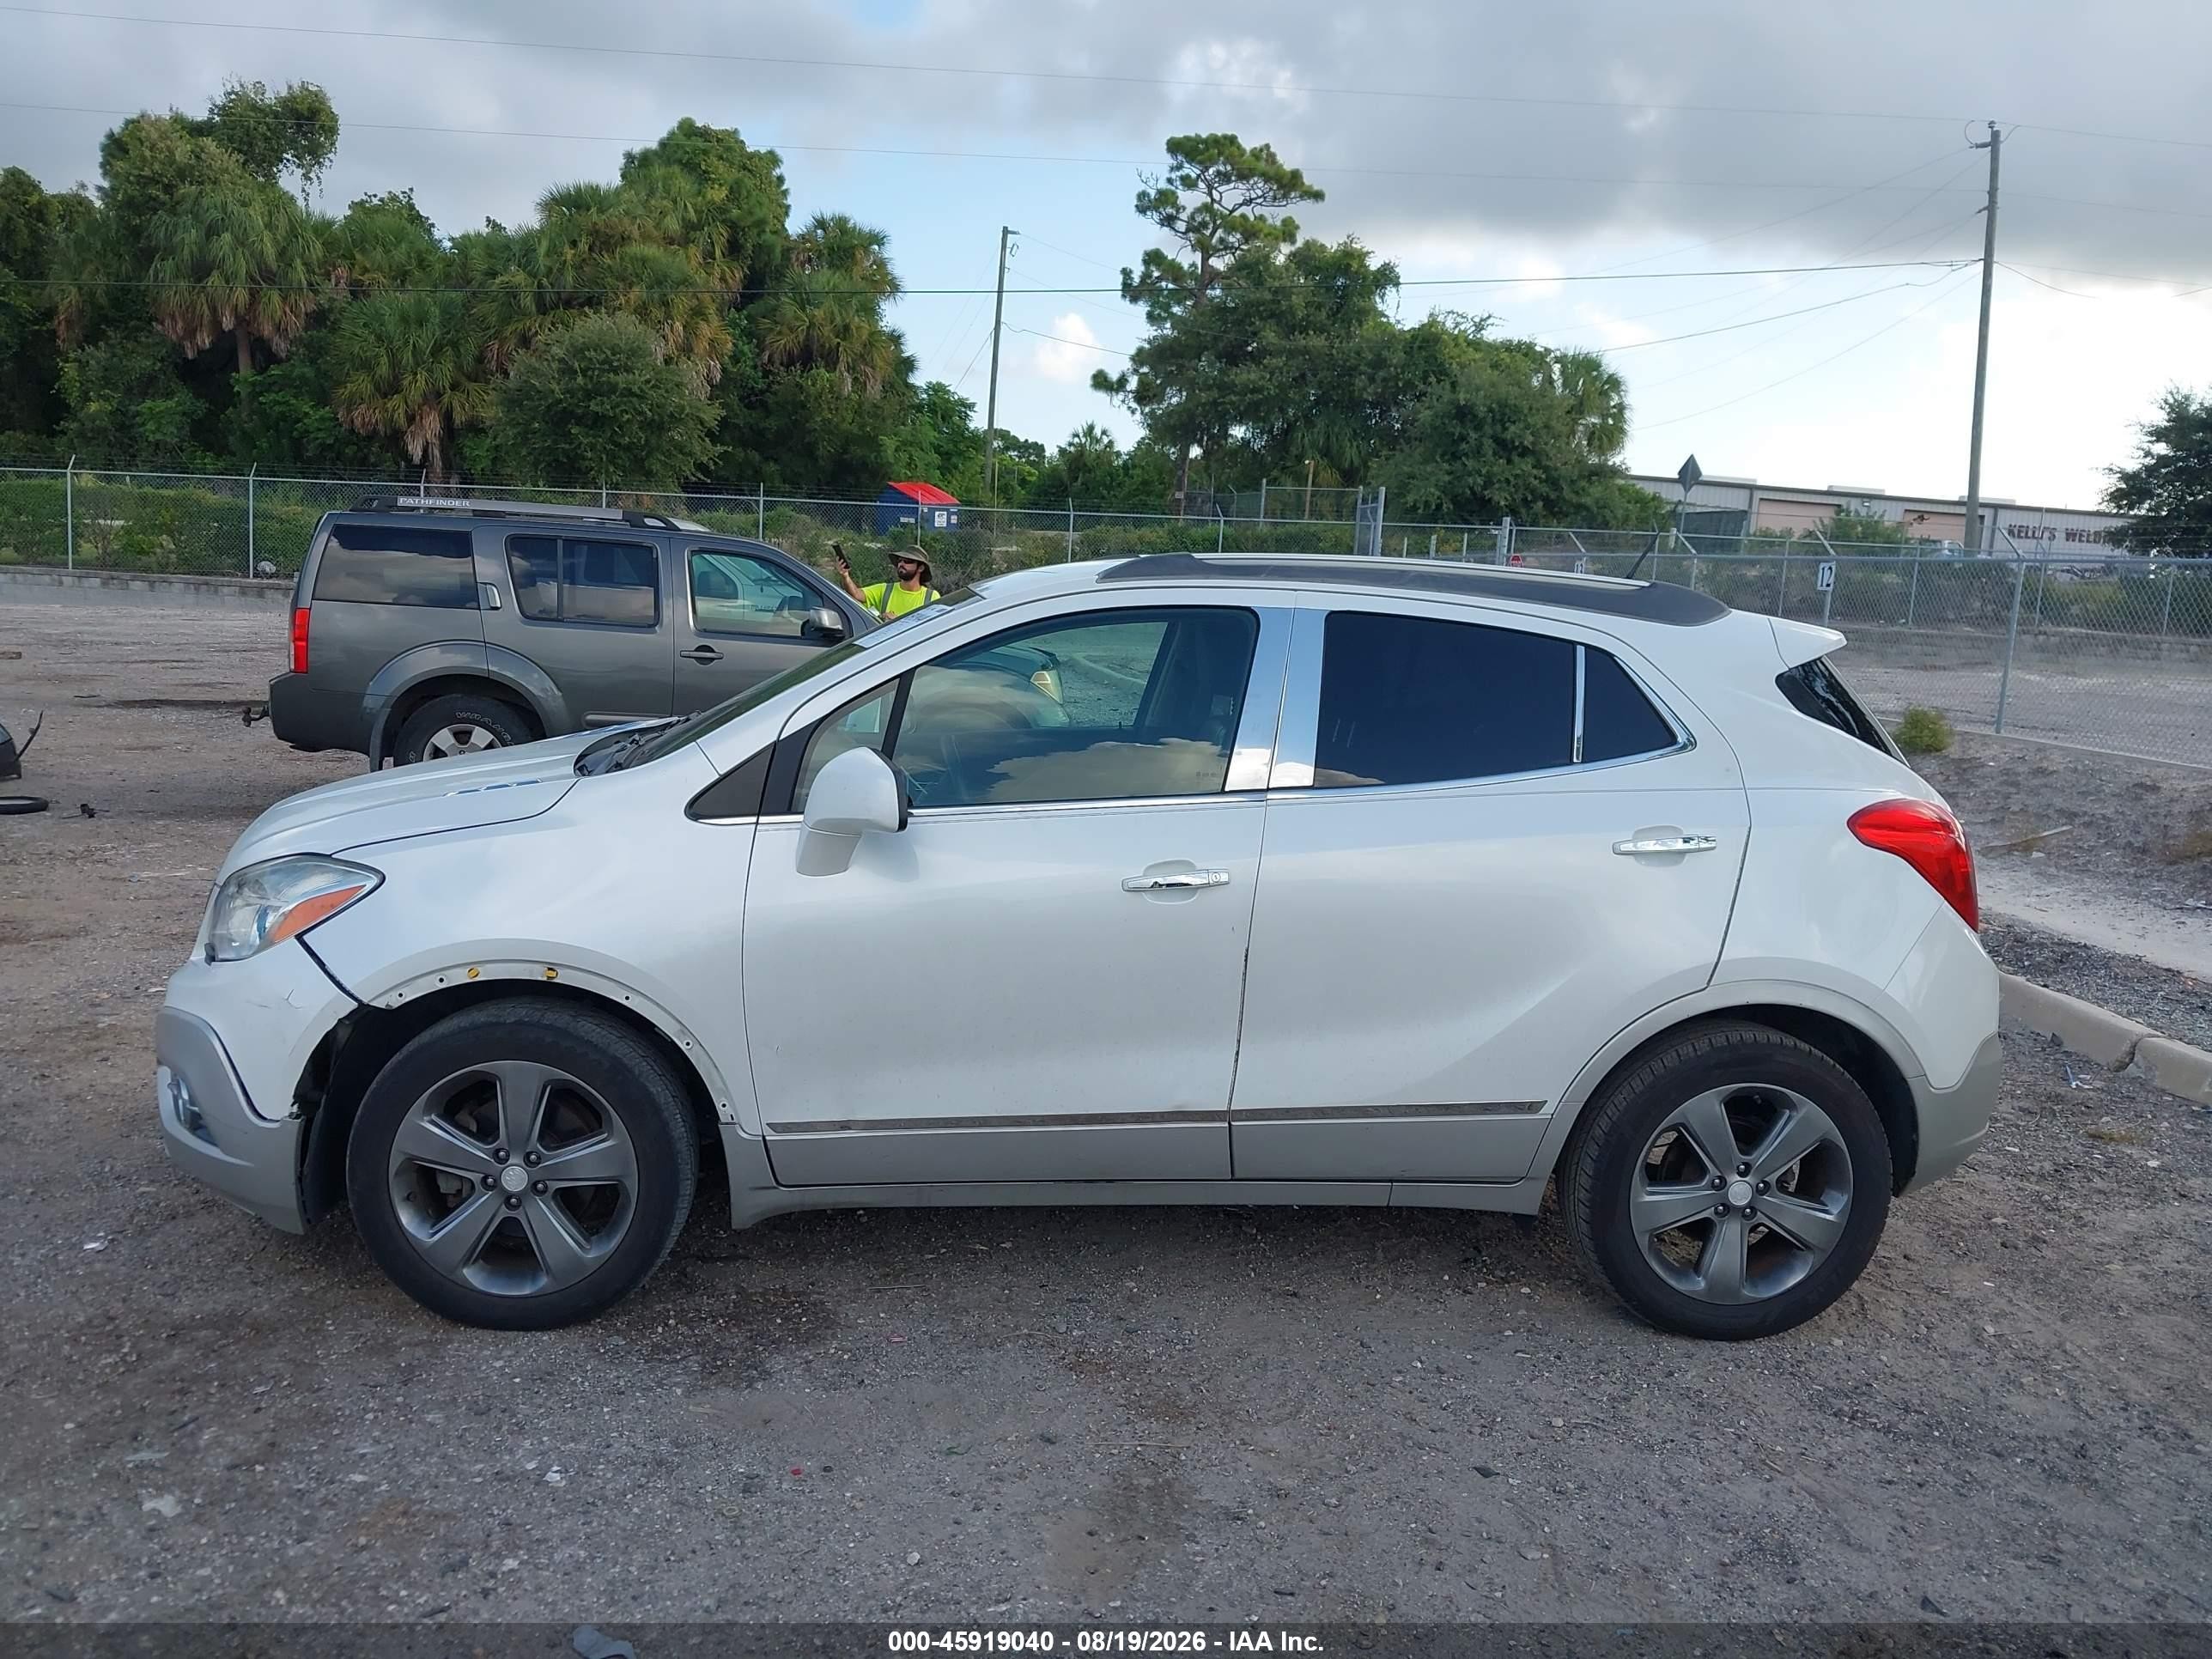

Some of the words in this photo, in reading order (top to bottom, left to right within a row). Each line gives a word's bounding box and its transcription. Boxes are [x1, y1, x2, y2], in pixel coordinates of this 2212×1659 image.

[398, 497, 471, 507] PATHFINDER
[2064, 527, 2106, 544] WELD
[1820, 566, 1833, 588] 12
